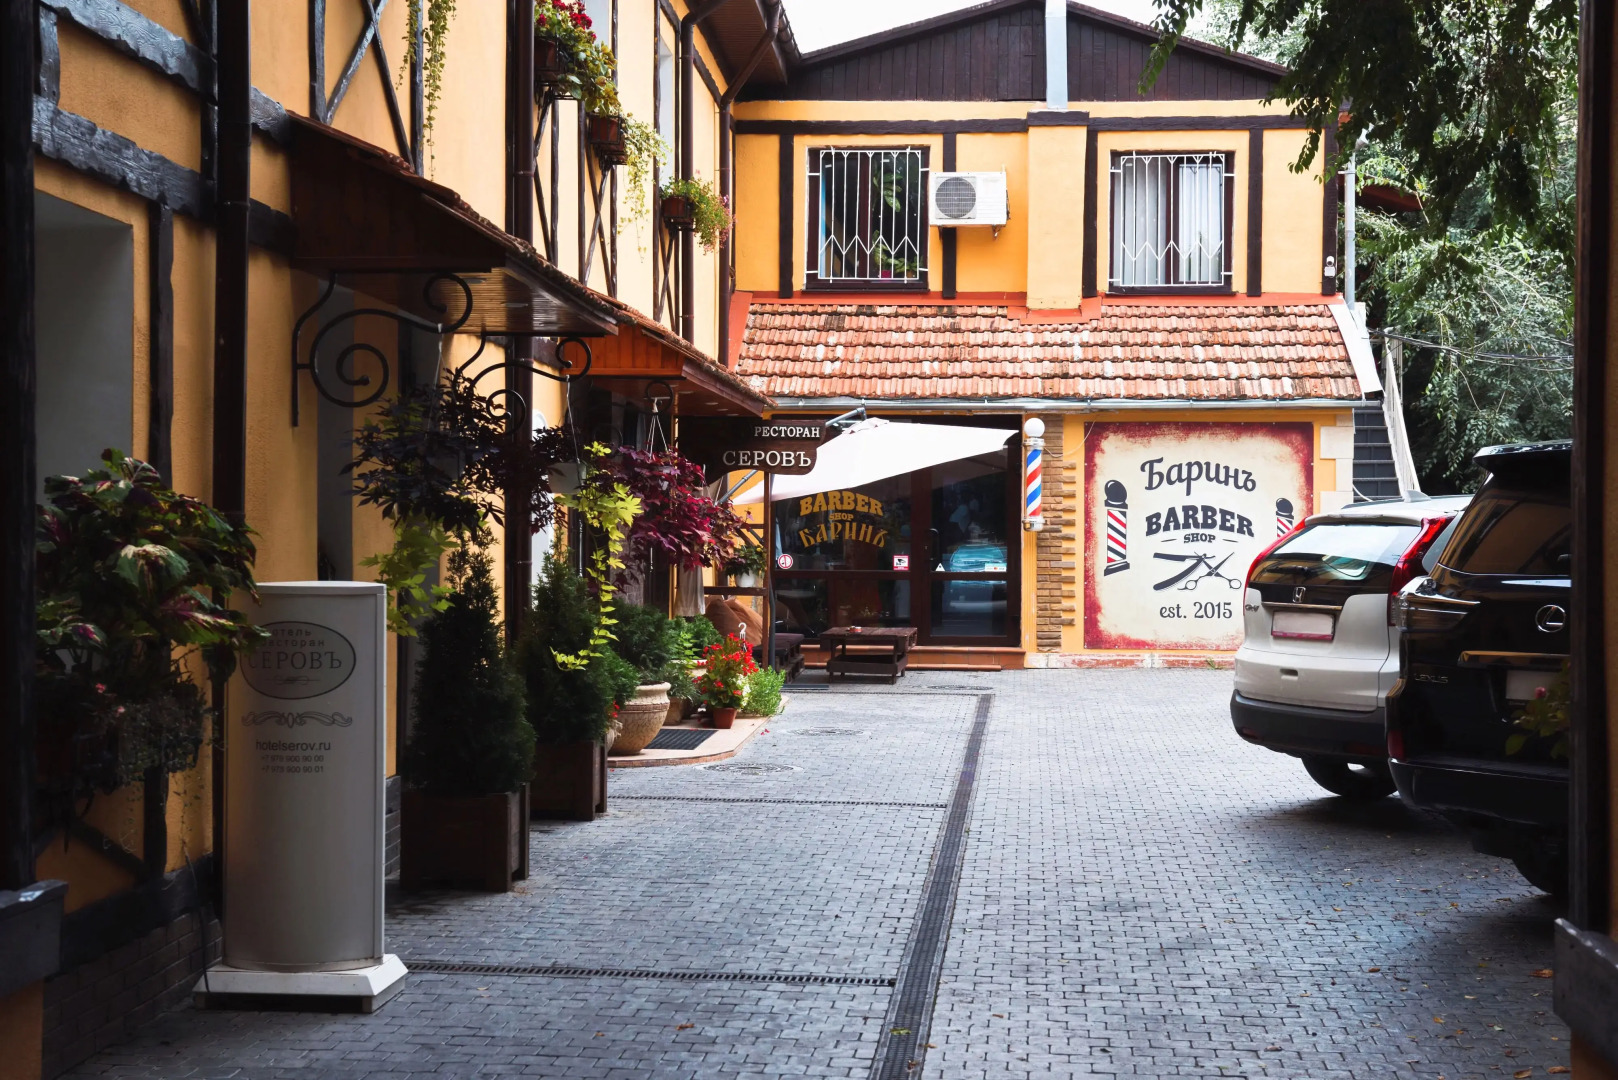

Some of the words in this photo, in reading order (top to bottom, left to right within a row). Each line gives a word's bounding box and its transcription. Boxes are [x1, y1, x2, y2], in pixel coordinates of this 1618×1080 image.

[754, 426, 820, 438] РЕСТОРАН
[722, 450, 812, 467] СЕРОВЪ
[1140, 457, 1257, 497] Баринъ
[799, 490, 884, 516] BARBER
[829, 512, 854, 521] SHOP
[1145, 504, 1255, 538] BARBER
[1183, 532, 1216, 544] SHOP
[1159, 603, 1188, 619] est.
[1193, 601, 1233, 620] 2015
[272, 628, 312, 638] отель
[248, 651, 342, 670] СЕРОВЪ
[255, 739, 331, 751] hotelserov.ru
